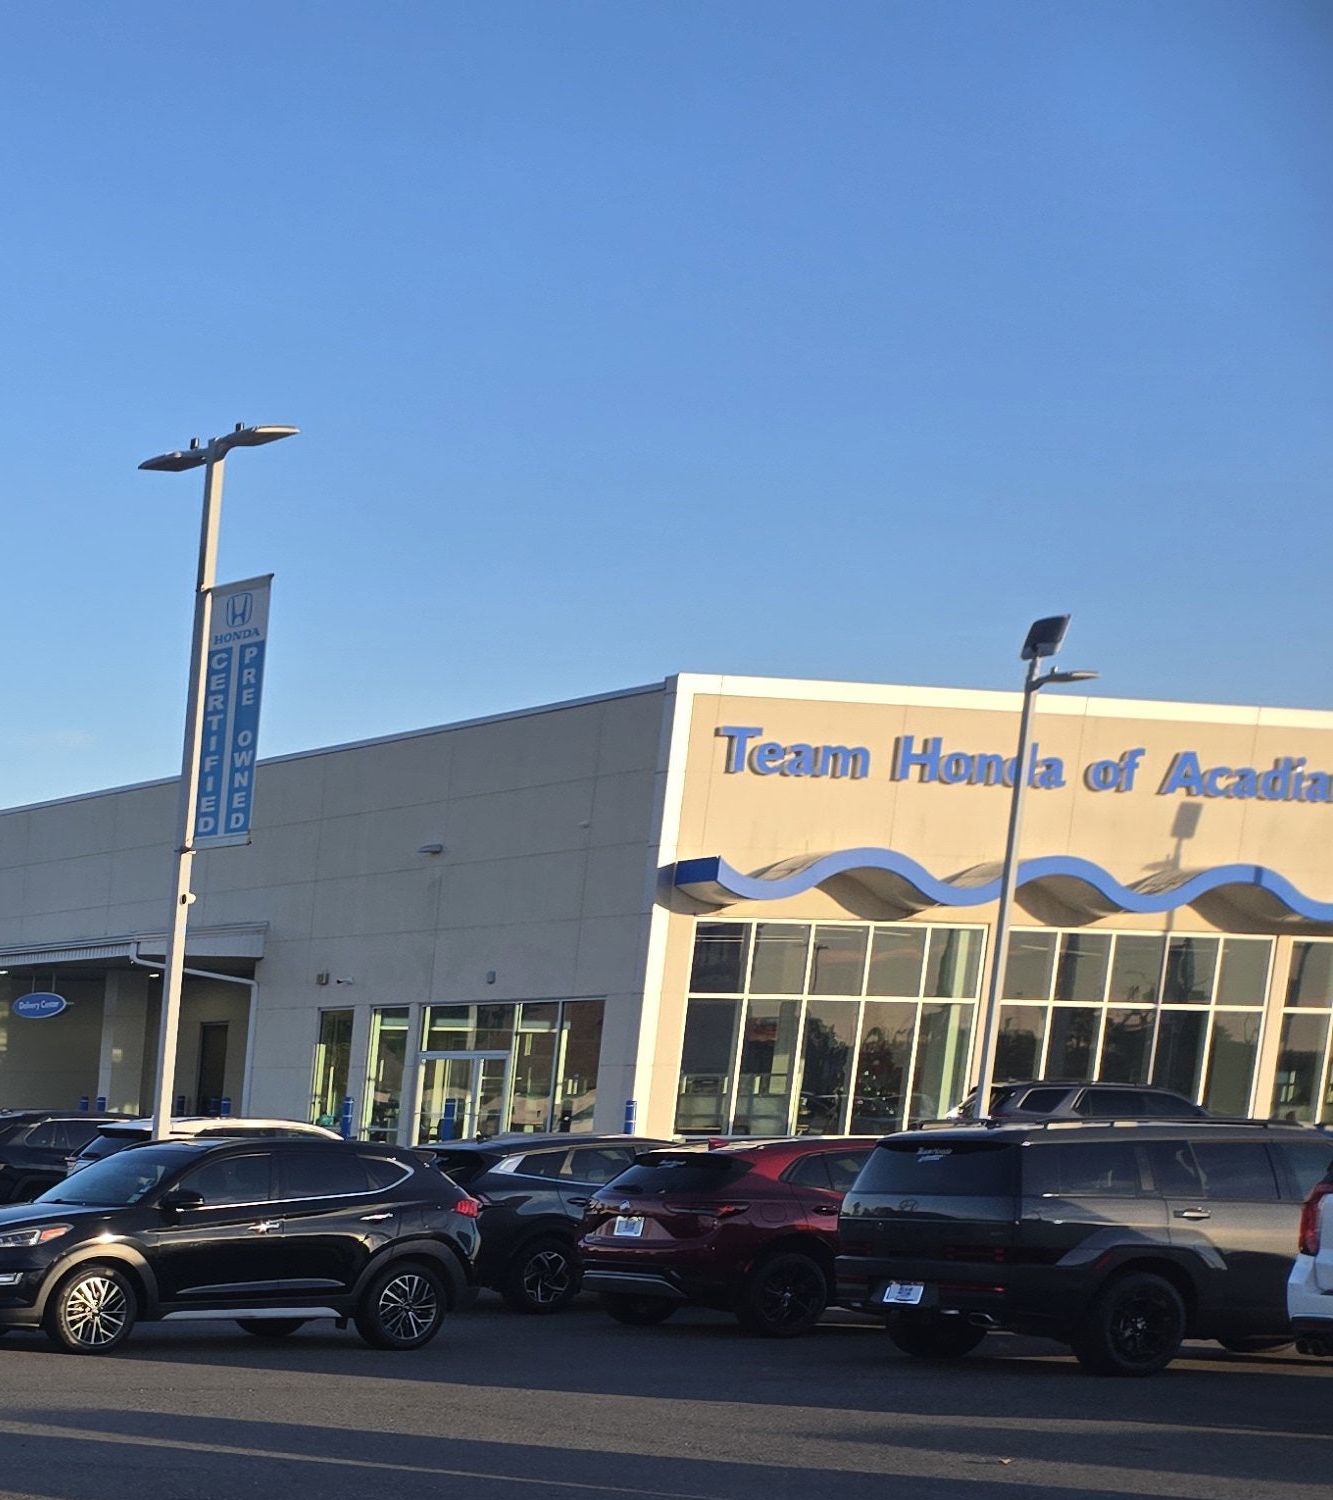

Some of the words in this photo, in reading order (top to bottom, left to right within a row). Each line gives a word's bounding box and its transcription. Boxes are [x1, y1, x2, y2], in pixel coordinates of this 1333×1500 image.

[213, 627, 260, 645] HONDA
[241, 647, 258, 706] PRE
[198, 652, 229, 833] CERTIFIED
[230, 729, 254, 830] OWNED
[715, 725, 870, 779] Team
[1085, 747, 1145, 792] of
[1158, 751, 1333, 803] Acadia
